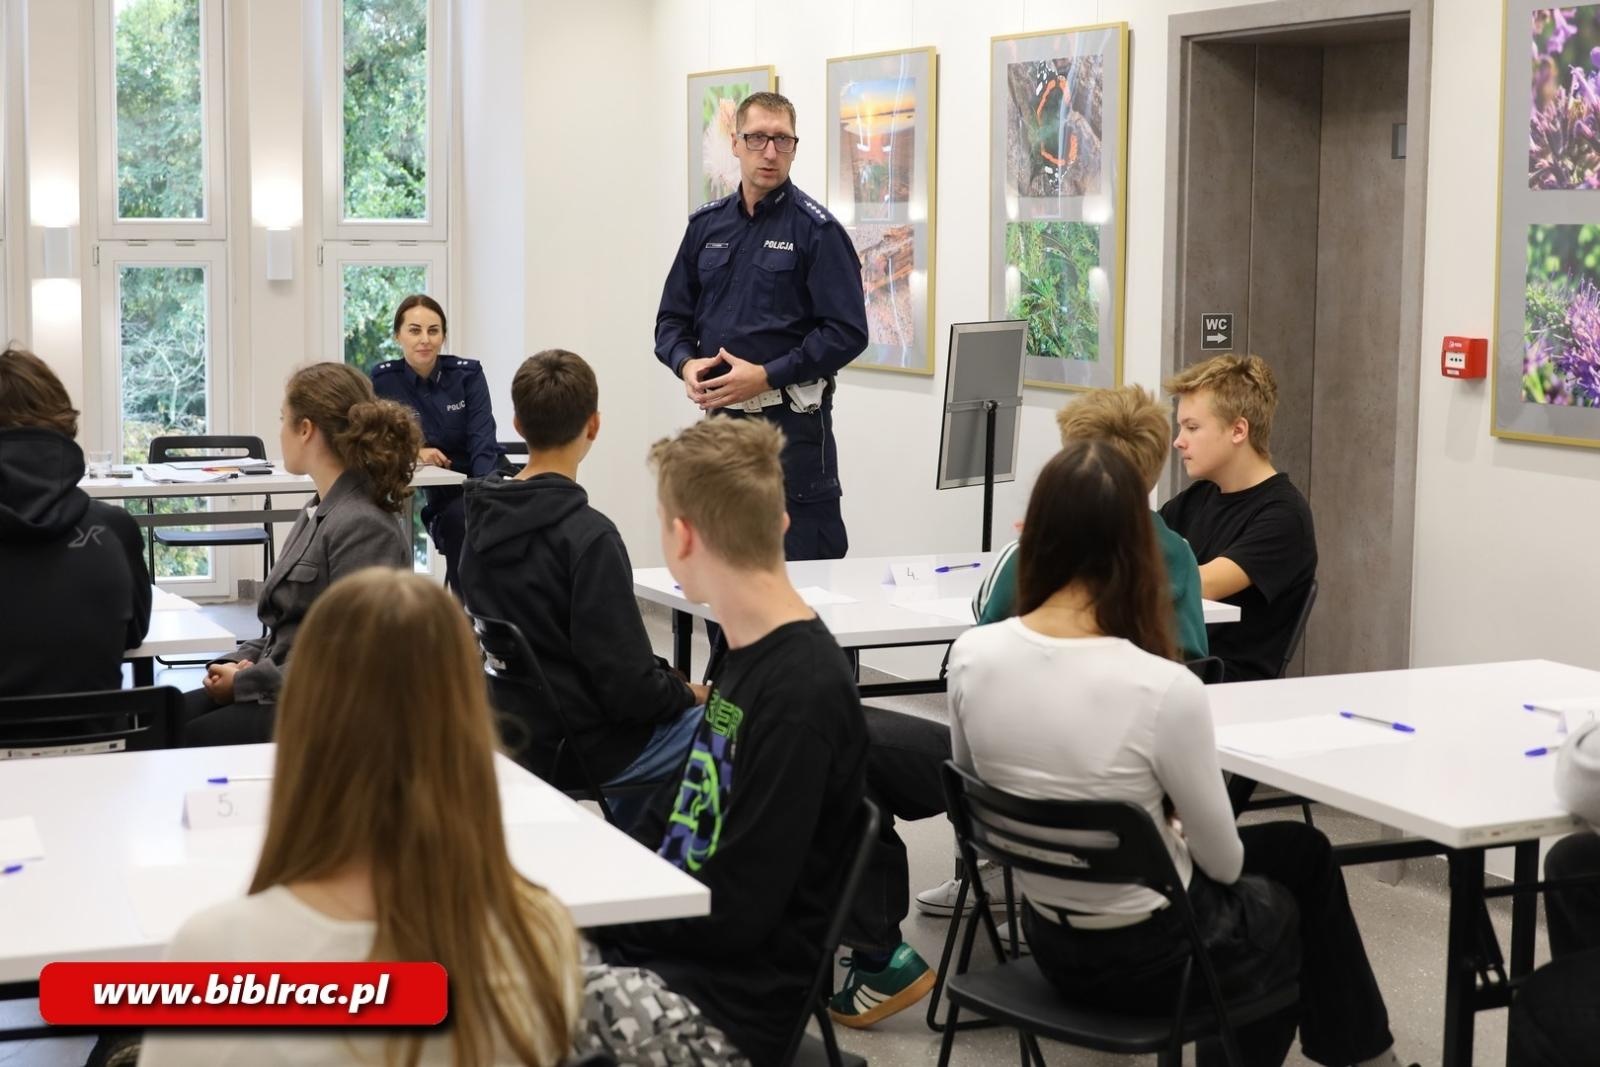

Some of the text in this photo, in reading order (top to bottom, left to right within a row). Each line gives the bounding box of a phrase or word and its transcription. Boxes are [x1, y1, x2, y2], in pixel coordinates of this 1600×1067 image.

[763, 239, 794, 251] POLICJA
[1205, 318, 1228, 330] WC
[446, 399, 466, 411] POLIC
